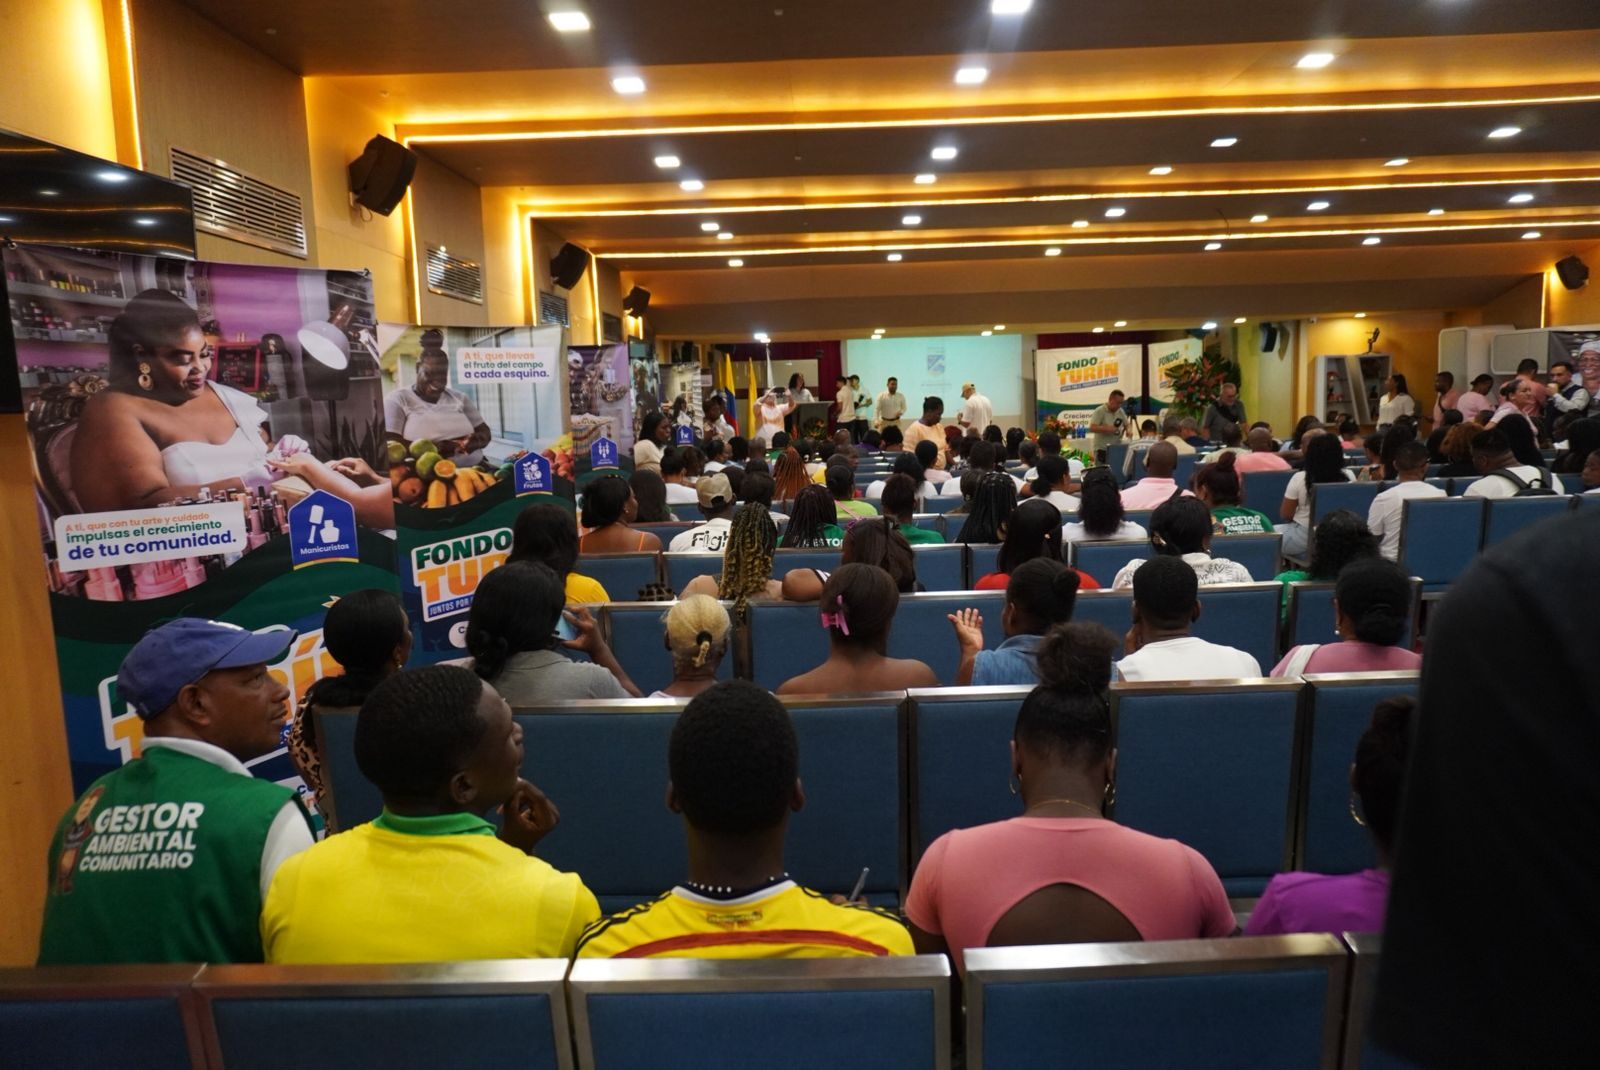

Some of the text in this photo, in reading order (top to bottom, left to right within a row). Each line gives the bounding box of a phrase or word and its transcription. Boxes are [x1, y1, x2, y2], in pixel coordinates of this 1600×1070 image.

[464, 352, 471, 360] A
[485, 353, 503, 361] que
[506, 352, 535, 360] llevas
[464, 361, 543, 369] el fruto del campo
[1057, 357, 1097, 371] FONDO
[474, 370, 501, 378] cada
[504, 369, 550, 380] esquina.
[1058, 360, 1119, 385] TURÍN
[66, 524, 73, 532] A
[88, 522, 107, 531] que
[142, 517, 162, 526] arte
[172, 512, 209, 522] cuidado
[1222, 515, 1261, 526] GESTOR
[66, 520, 222, 544] impulsas el crecimiento
[68, 530, 237, 560] de tu comunidad.
[300, 544, 350, 555] Manicuristas
[416, 530, 512, 570] FONDO
[430, 601, 454, 616] JUNTOS
[455, 598, 469, 608] POR
[94, 801, 205, 833] GESTOR
[85, 830, 197, 855] AMBIENTAL
[79, 852, 194, 872] COMUNITARIO
